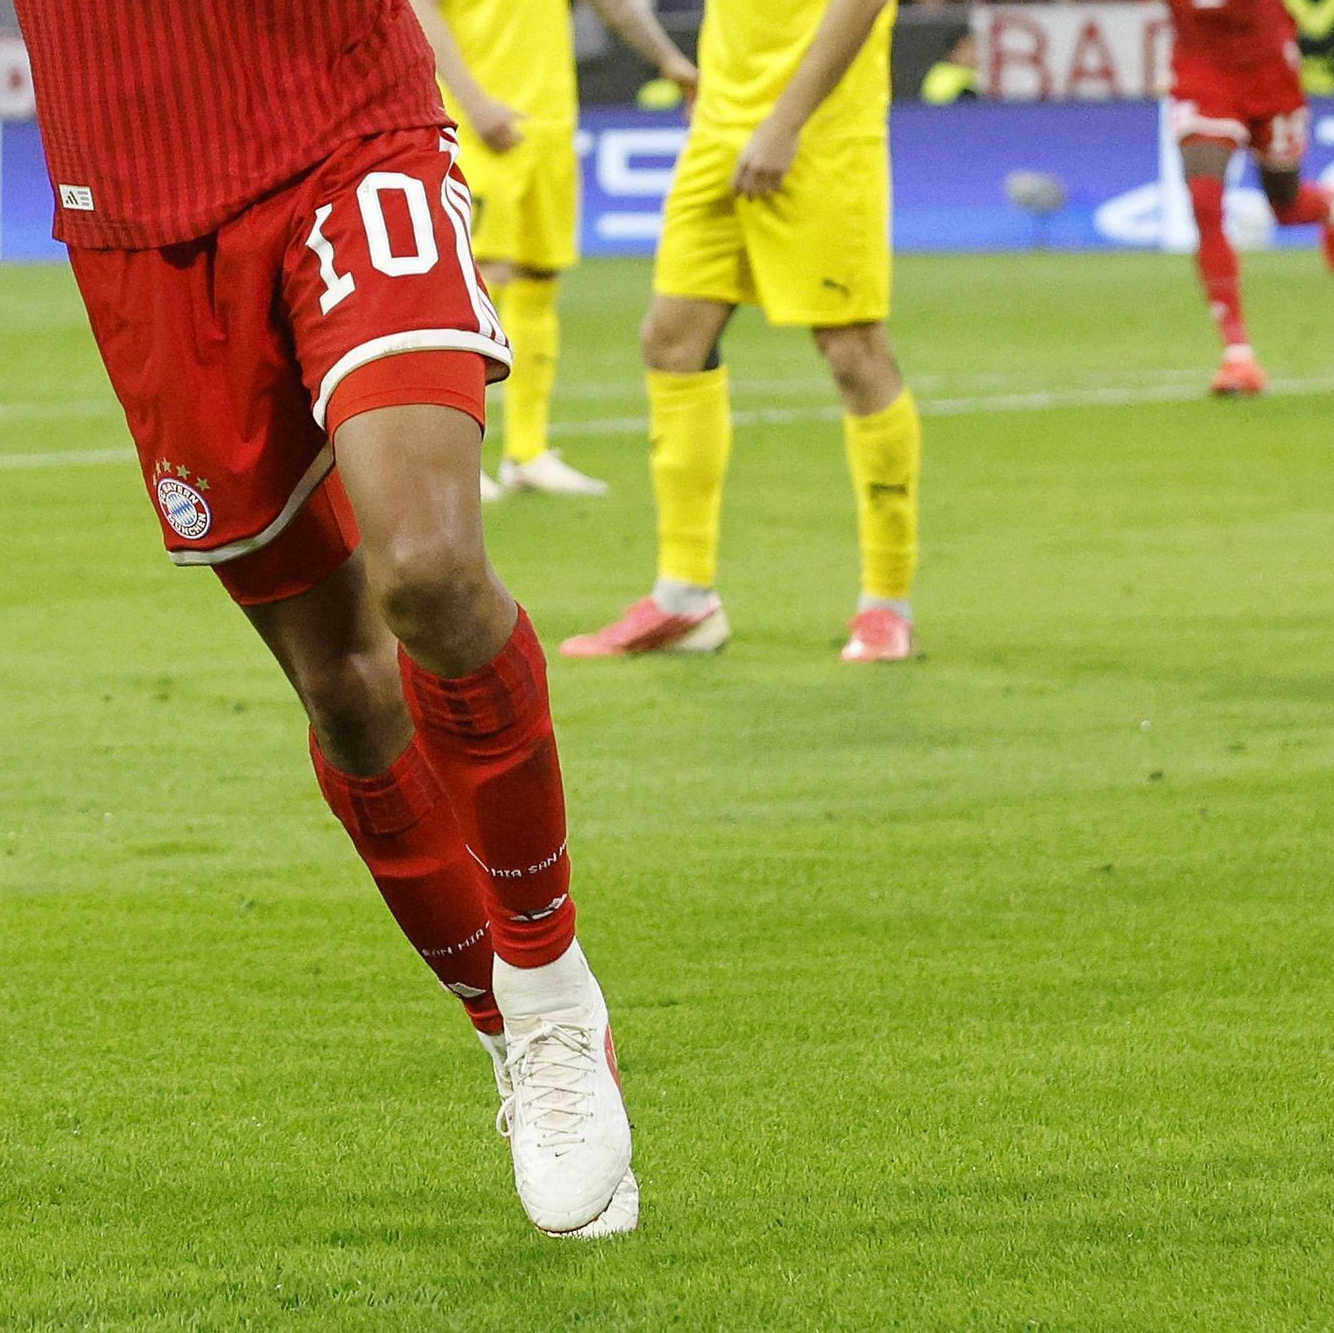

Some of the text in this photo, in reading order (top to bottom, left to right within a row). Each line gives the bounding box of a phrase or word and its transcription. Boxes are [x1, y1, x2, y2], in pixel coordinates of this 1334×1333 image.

[305, 172, 440, 316] 10
[162, 482, 199, 504] BAYERN
[528, 852, 558, 875] SAN
[458, 928, 484, 951] MIA
